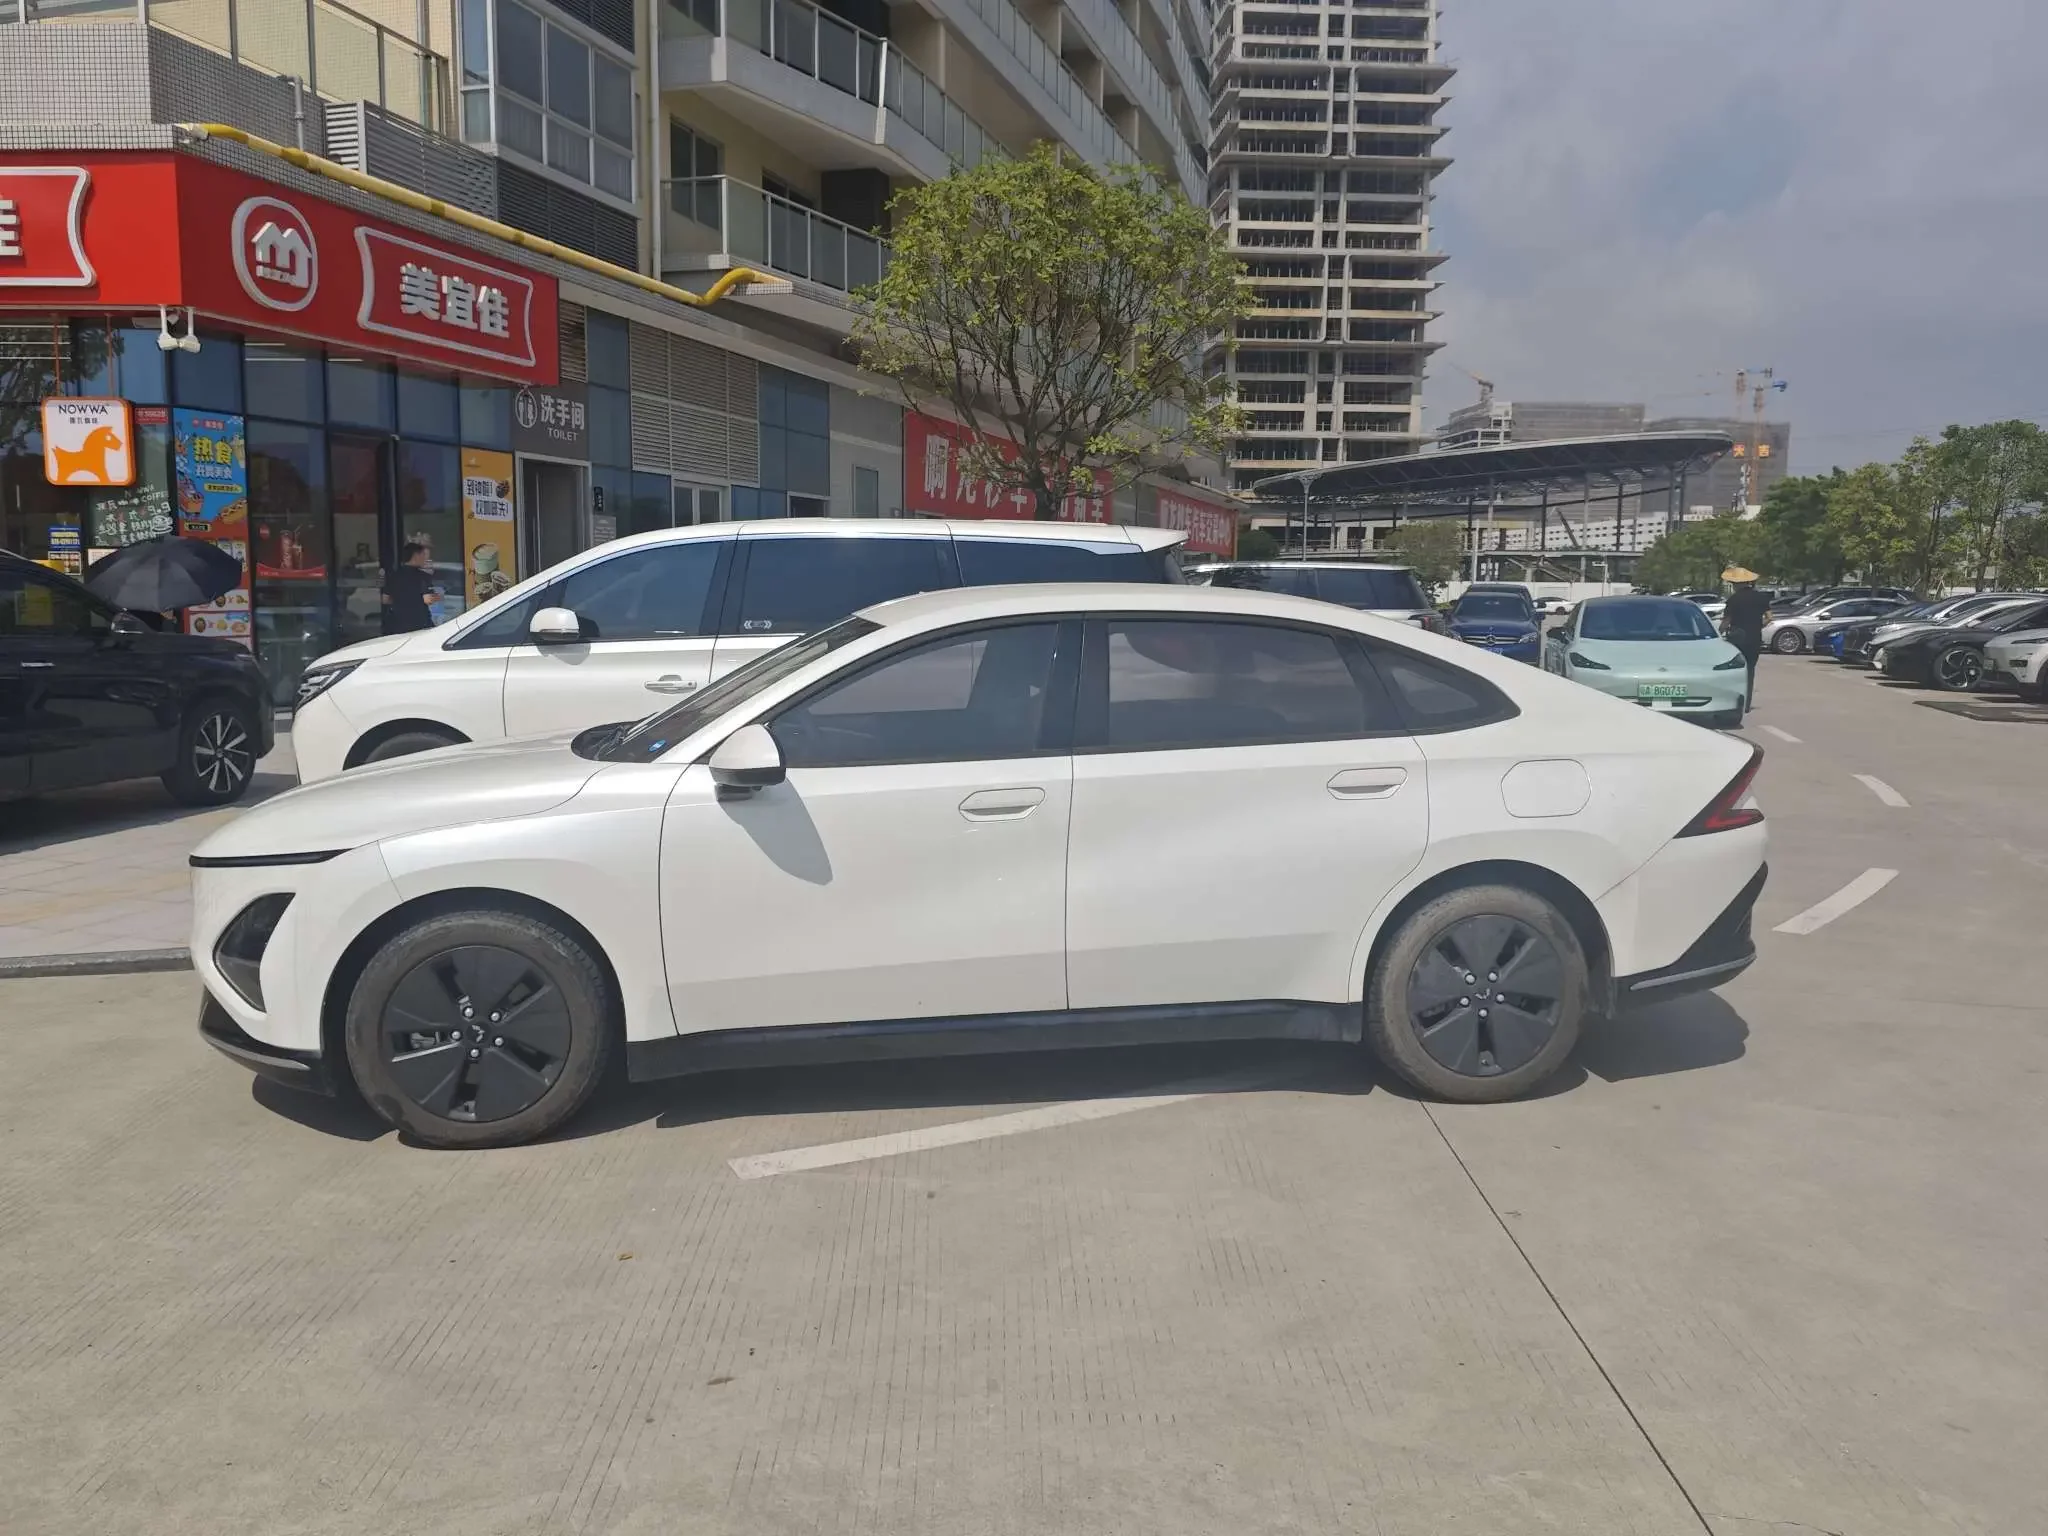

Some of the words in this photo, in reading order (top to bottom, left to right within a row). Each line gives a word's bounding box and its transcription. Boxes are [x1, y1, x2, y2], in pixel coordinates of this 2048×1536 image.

[400, 262, 509, 338] 美宜佳
[58, 404, 109, 415] NOWWA
[541, 394, 585, 430] 洗手间
[547, 427, 578, 441] TOILET
